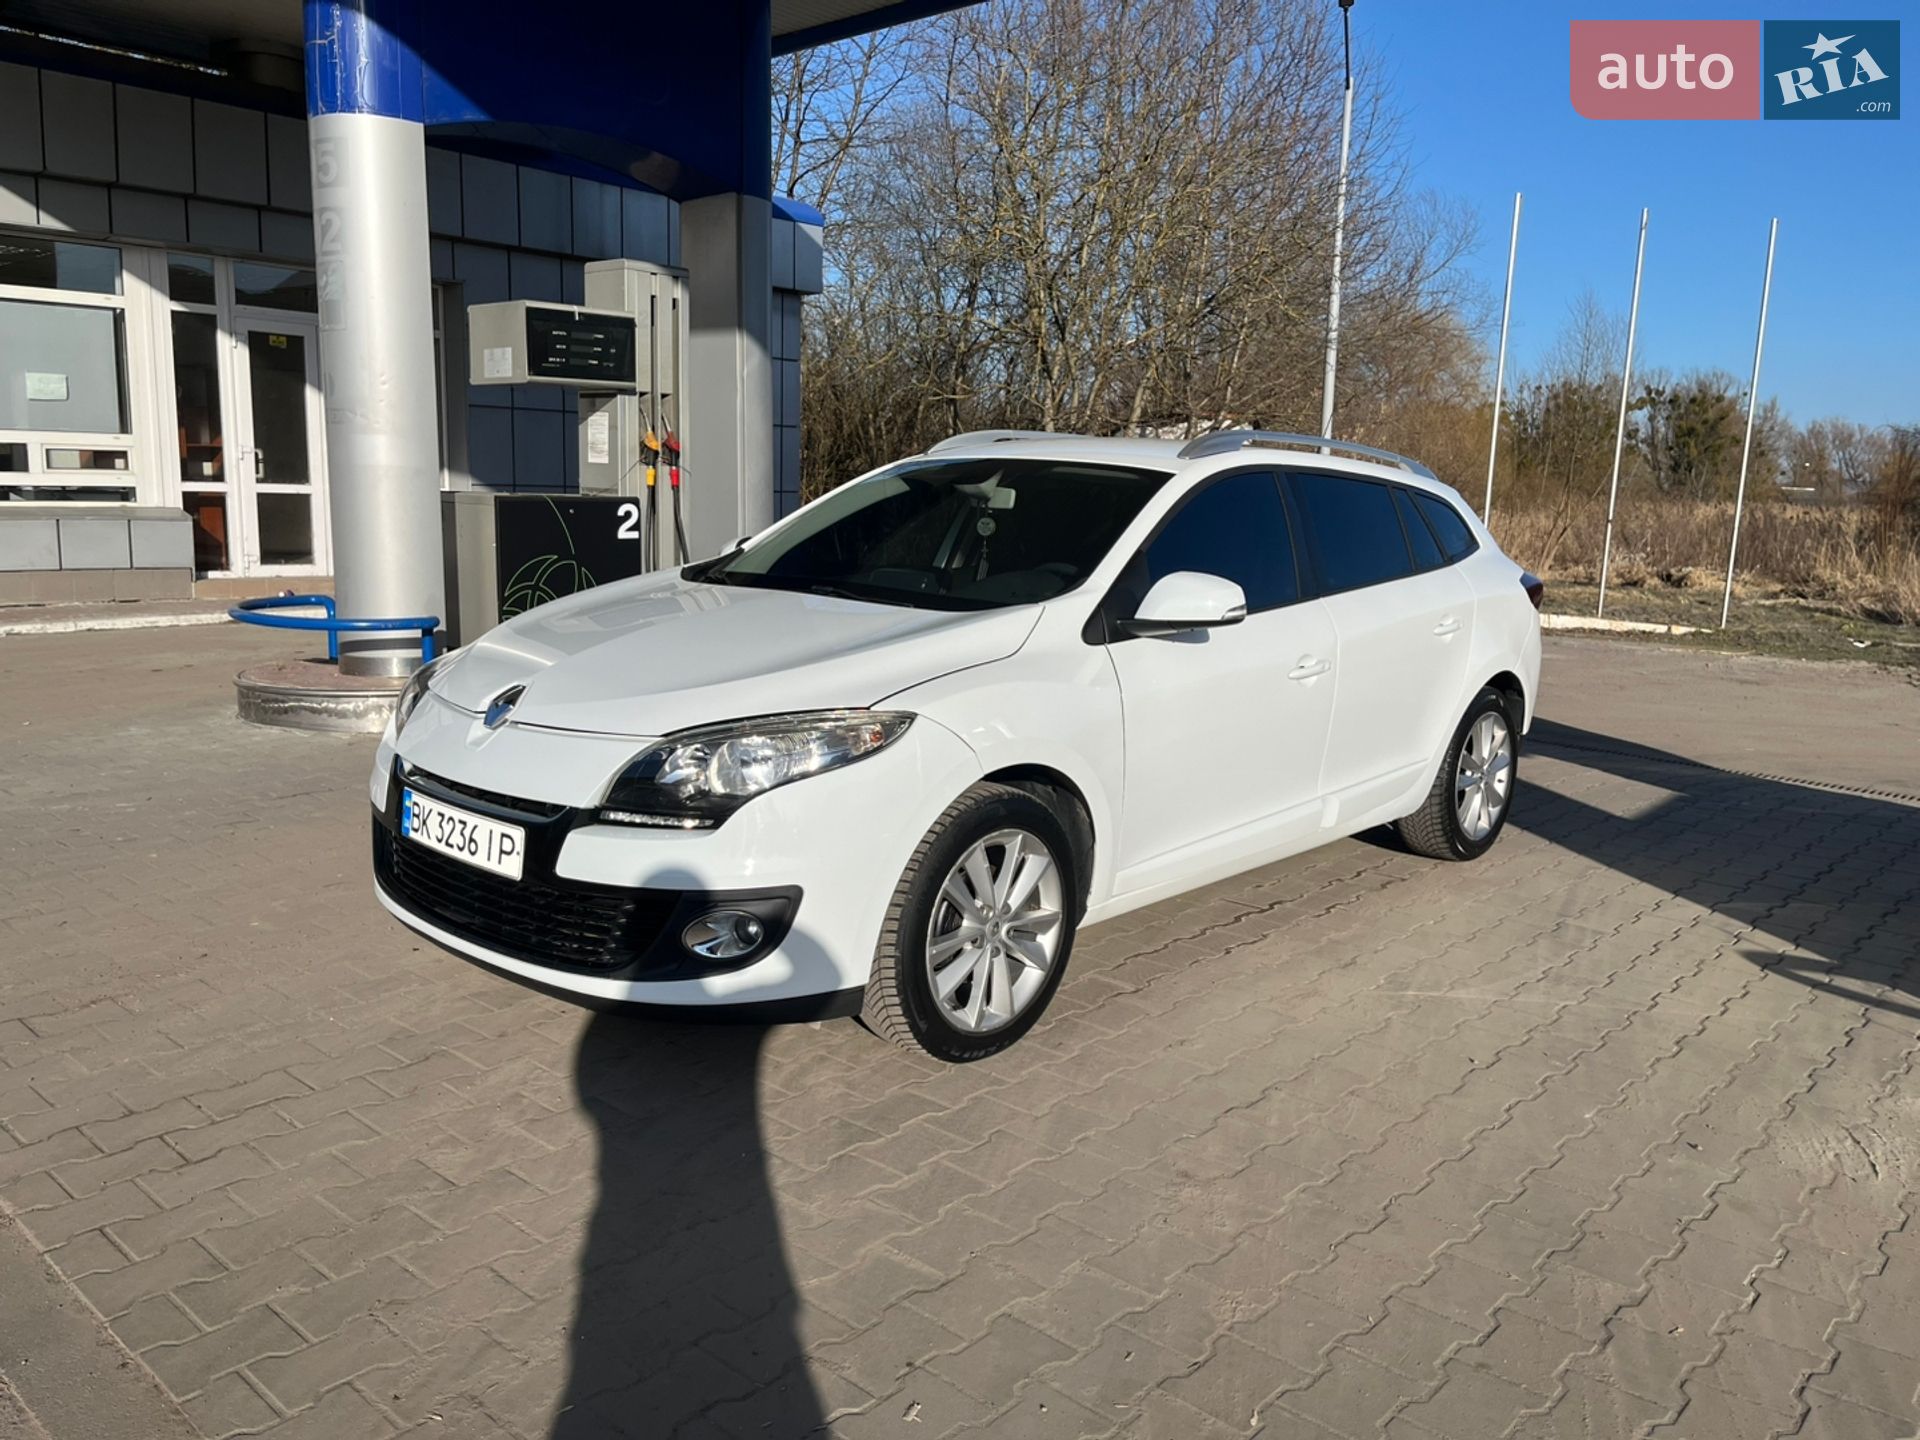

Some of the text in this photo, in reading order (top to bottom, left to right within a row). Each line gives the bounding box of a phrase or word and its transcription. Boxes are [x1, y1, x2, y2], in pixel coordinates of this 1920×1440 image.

[617, 503, 640, 540] 2
[410, 801, 516, 866] BK 3236 IP
